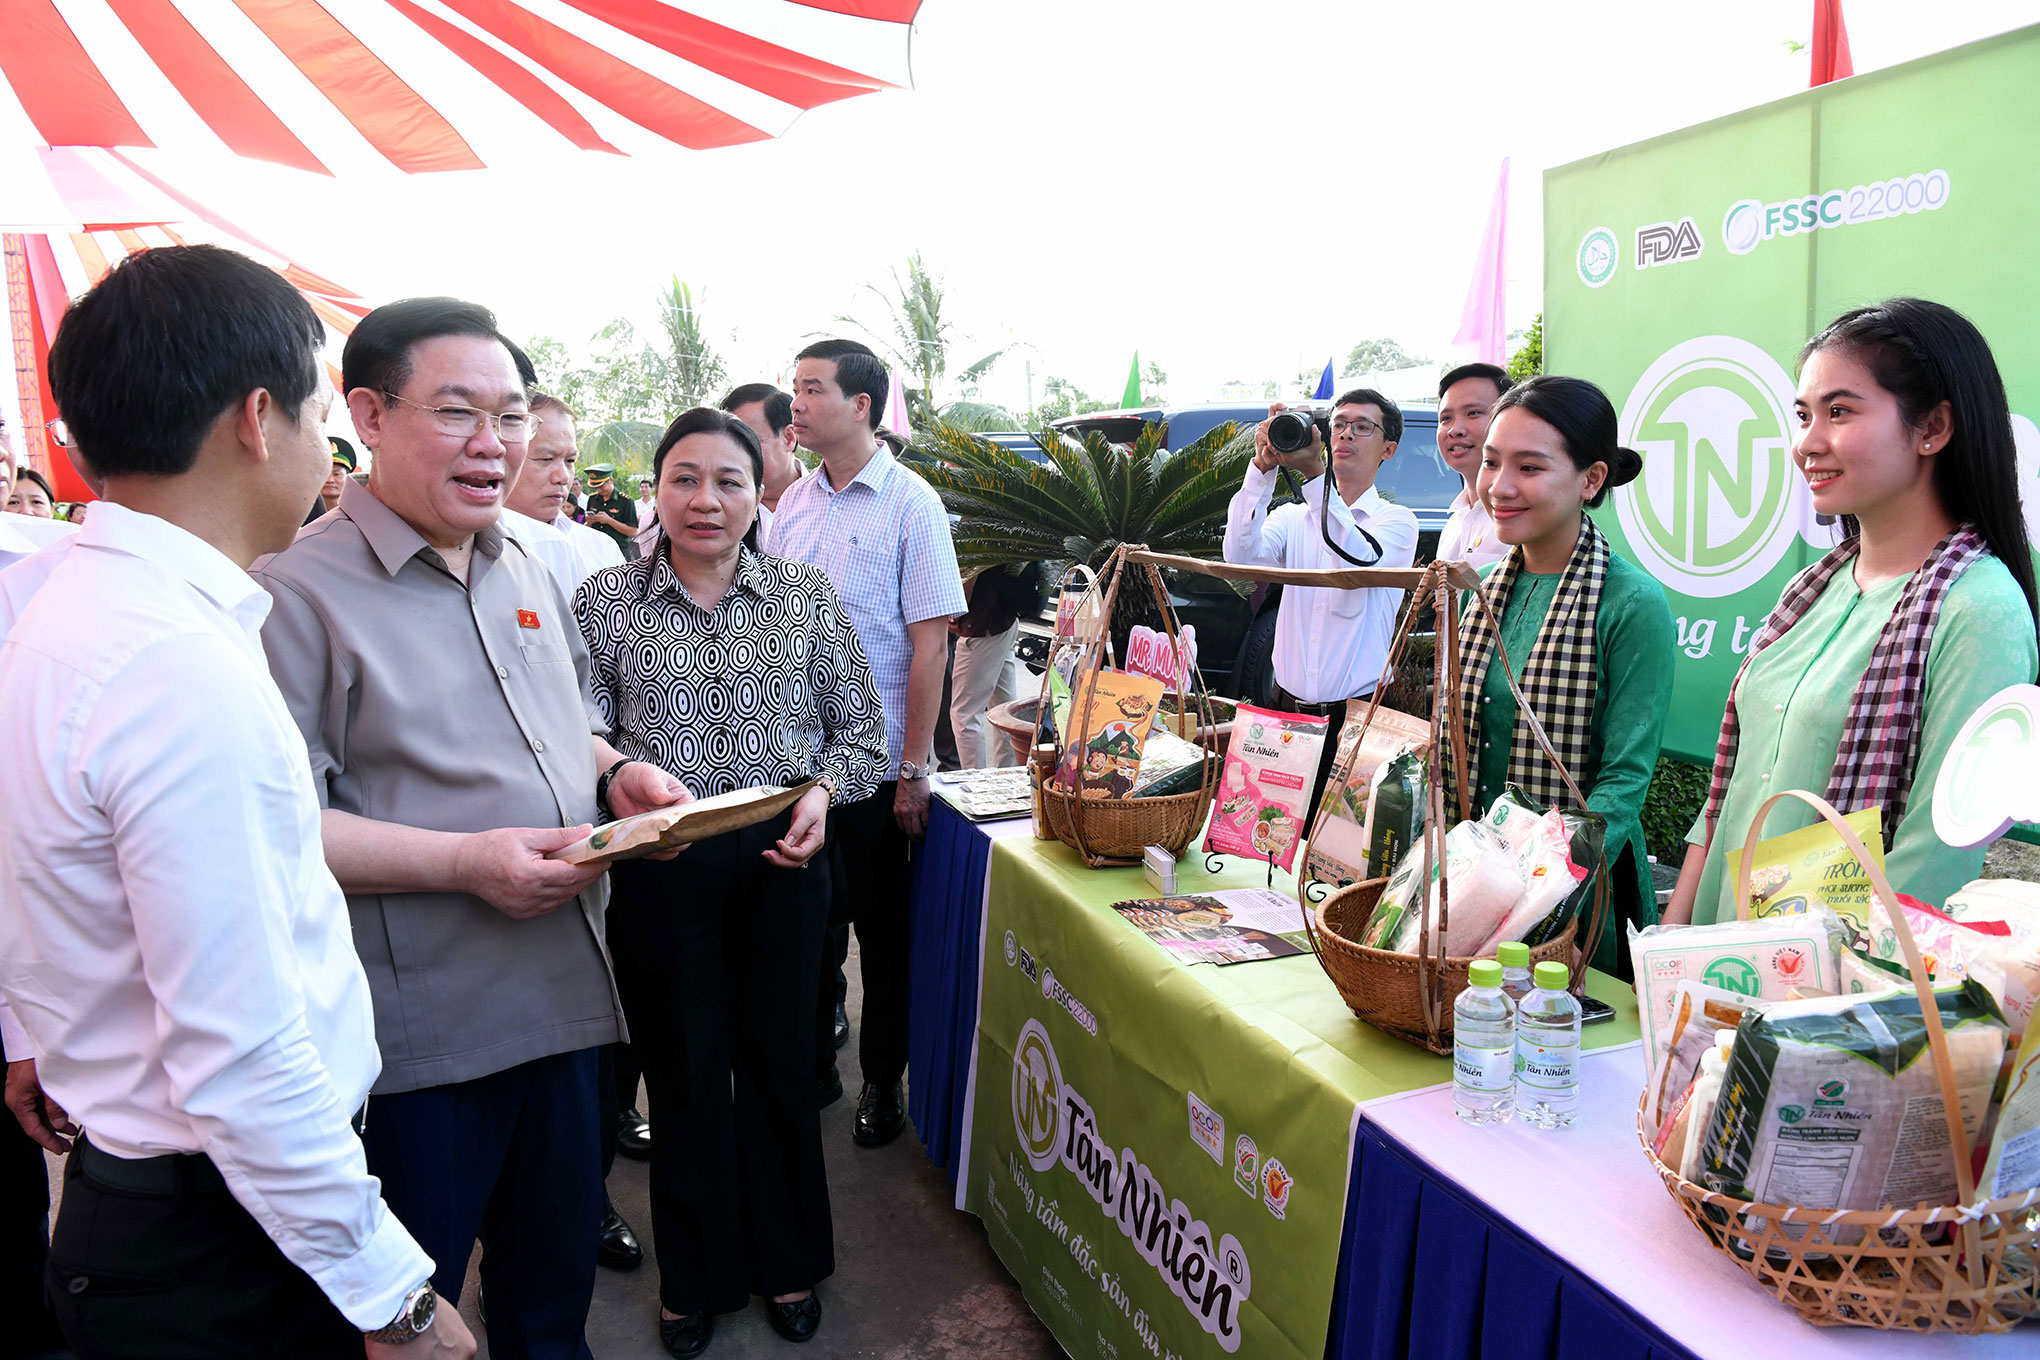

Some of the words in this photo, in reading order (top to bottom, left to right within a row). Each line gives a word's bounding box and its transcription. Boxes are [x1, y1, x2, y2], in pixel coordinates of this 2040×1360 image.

[1764, 194, 1842, 235] FSSC
[1637, 220, 1702, 267] FDA
[1242, 743, 1256, 754] Tân
[1256, 746, 1281, 758] Nhiên
[1020, 948, 1037, 982] FDA
[1458, 1063, 1483, 1078] Nhiên
[1526, 1063, 1542, 1076] Tân
[1543, 1067, 1571, 1077] Nhiên
[1191, 1105, 1220, 1134] OCOP
[1808, 1109, 1831, 1120] Tân
[1833, 1110, 1873, 1121] Nhiên
[1065, 1096, 1114, 1205] Tân
[1118, 1161, 1233, 1337] Nhiên
[1036, 1195, 1069, 1246] tầm
[1069, 1233, 1098, 1280] đặc
[1100, 1271, 1131, 1319] sản
